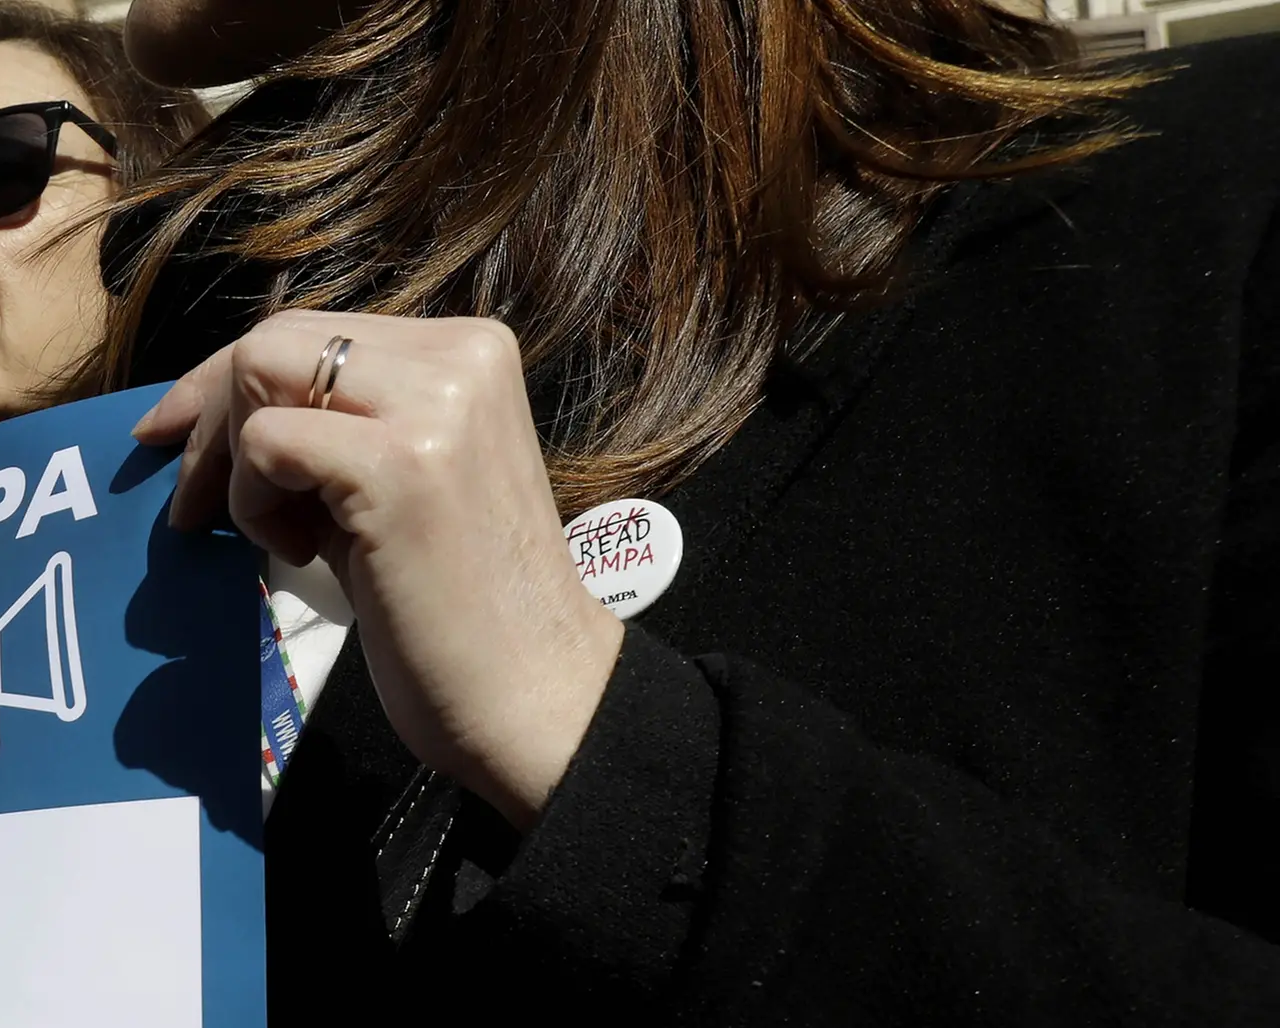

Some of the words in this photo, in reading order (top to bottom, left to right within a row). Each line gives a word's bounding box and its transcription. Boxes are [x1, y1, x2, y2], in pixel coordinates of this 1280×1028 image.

[580, 518, 651, 563] READ
[577, 543, 654, 581] AMPA
[600, 590, 638, 606] AMPA
